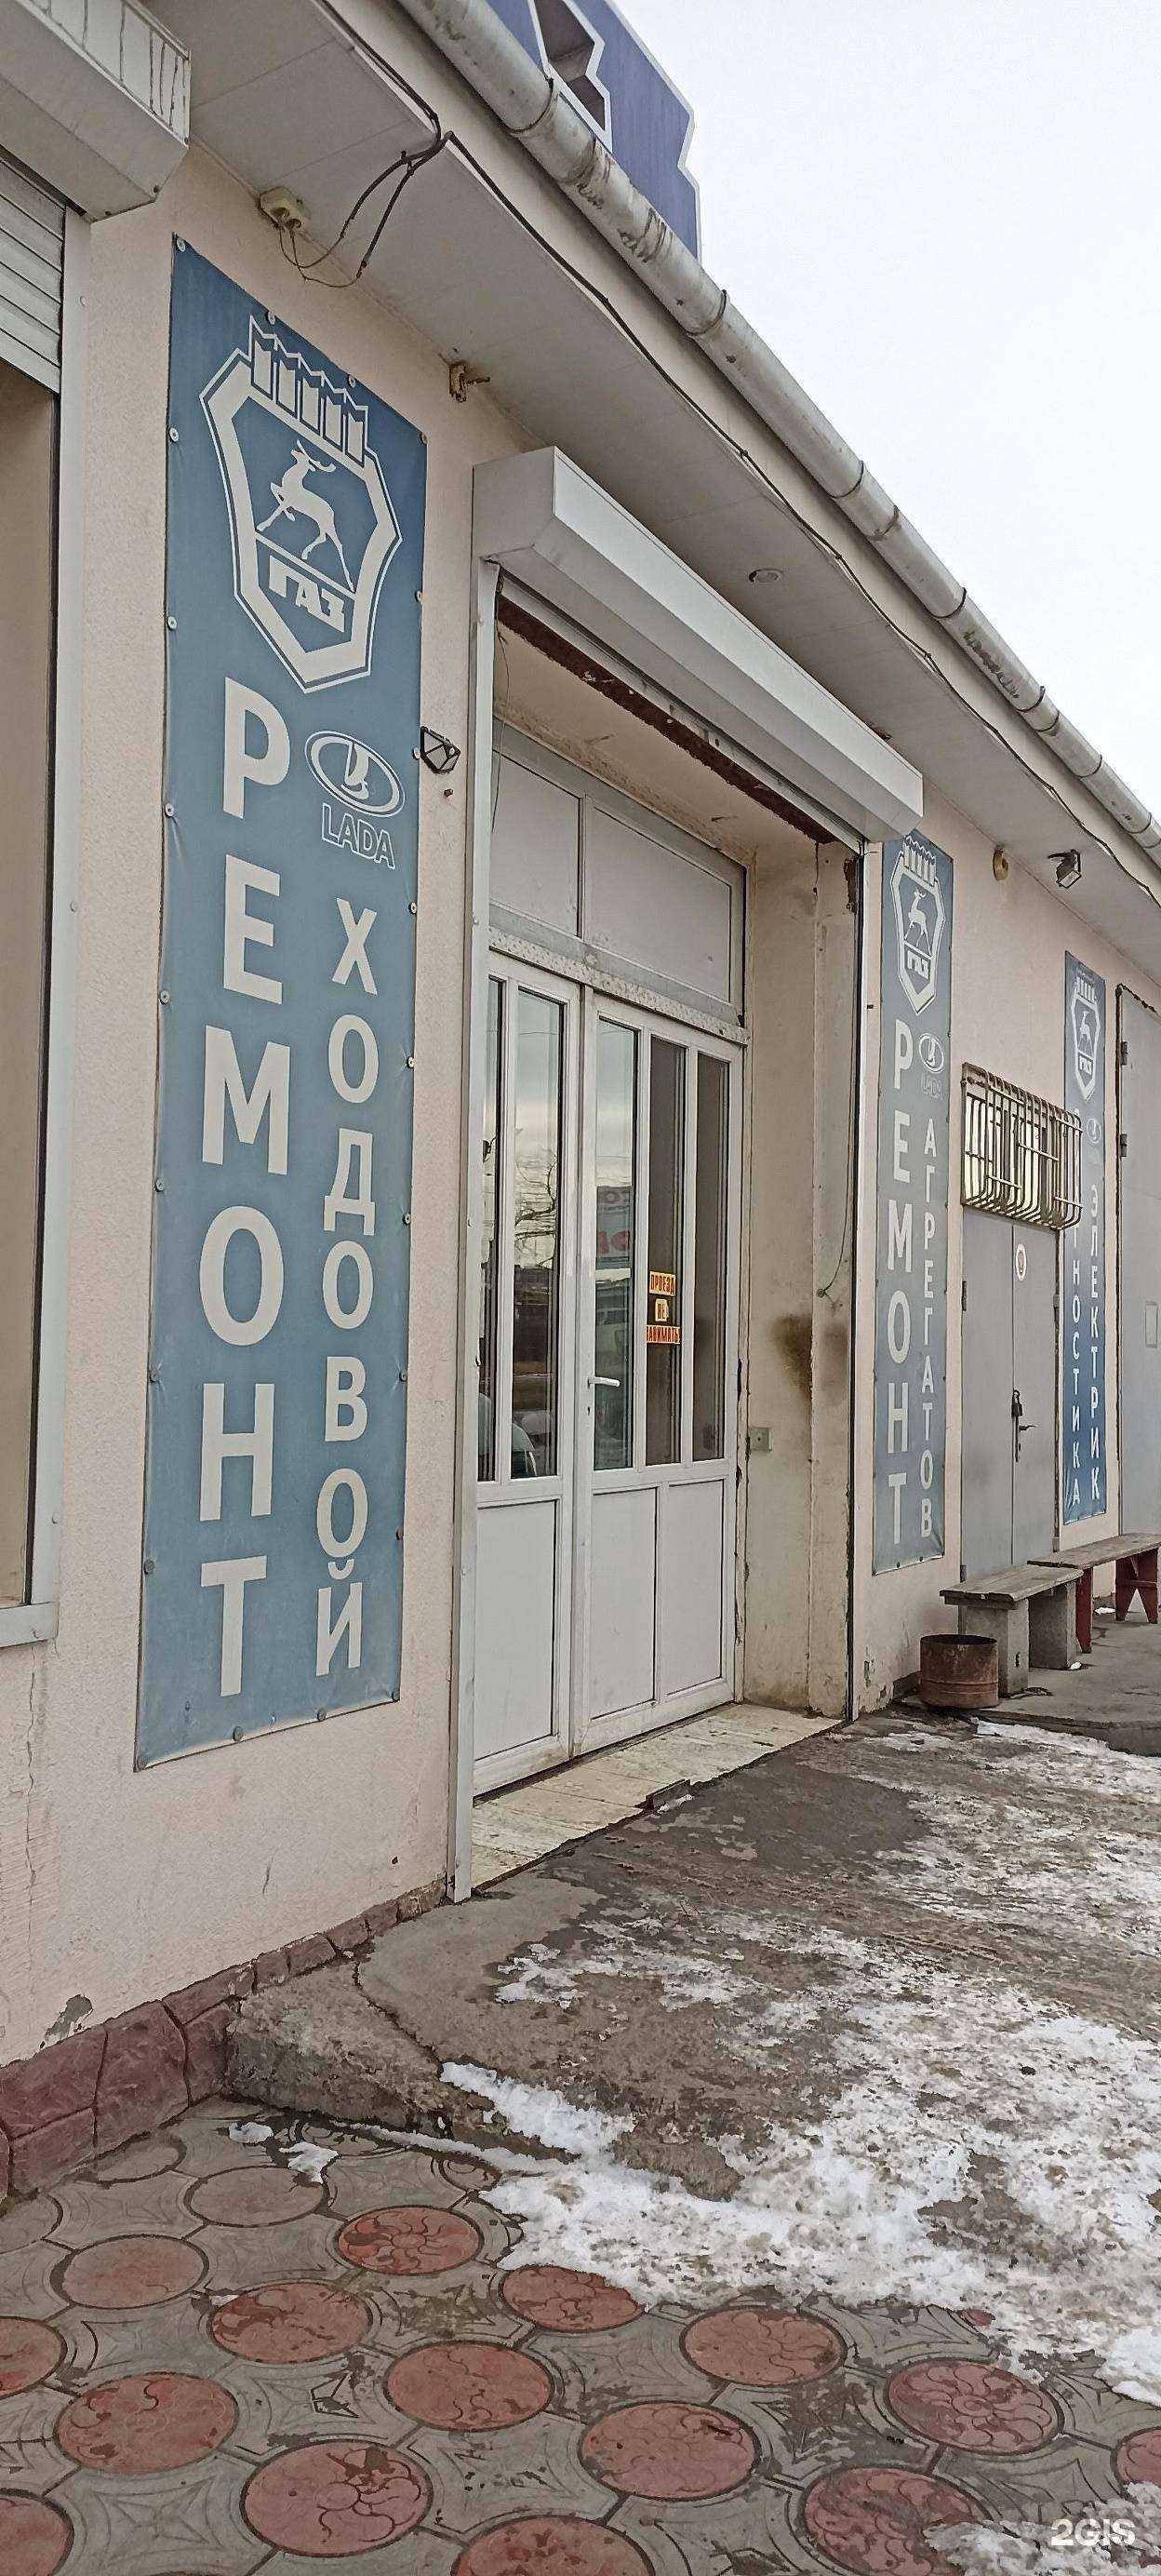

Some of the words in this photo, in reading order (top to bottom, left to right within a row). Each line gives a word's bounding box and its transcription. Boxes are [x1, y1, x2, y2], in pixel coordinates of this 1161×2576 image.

[269, 556, 345, 633] ГАЗ
[321, 803, 396, 870] LADA
[198, 677, 291, 1698] РЕМОНТ
[314, 896, 380, 1677] ХОДОВОЙ
[650, 1274, 674, 1295] ПРОЕЗД
[887, 1018, 914, 1545] РЕМОНТ
[920, 1118, 937, 1538] АГРЕГАТОВ
[1090, 1184, 1100, 1500] ЭЛЕКТРИК
